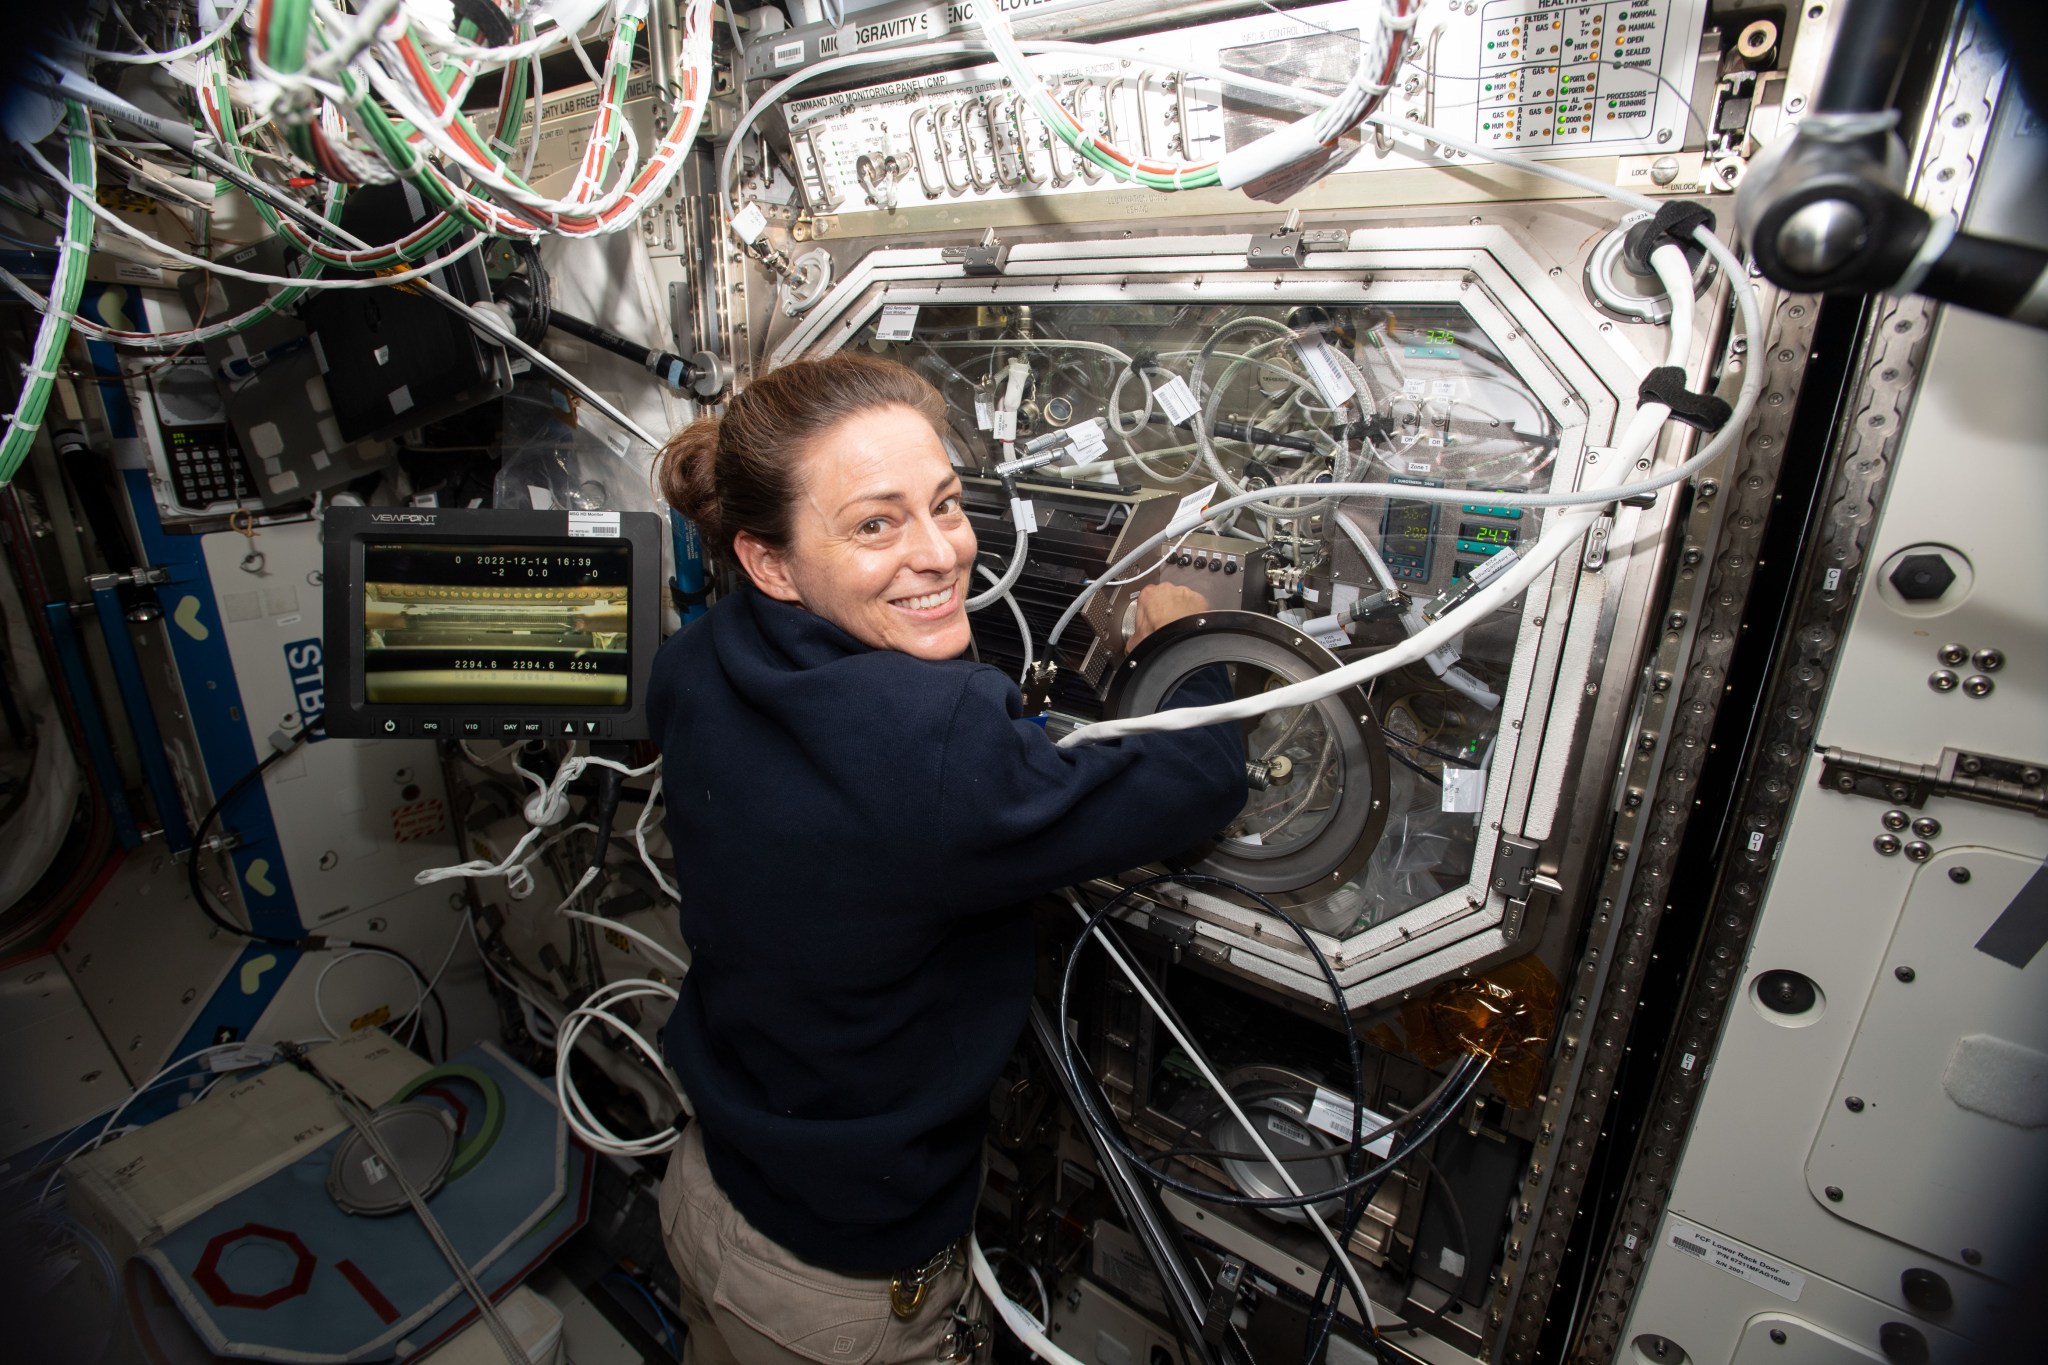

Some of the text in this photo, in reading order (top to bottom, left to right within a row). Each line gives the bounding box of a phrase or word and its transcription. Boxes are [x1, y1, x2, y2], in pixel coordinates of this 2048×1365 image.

[1524, 14, 1549, 23] FILTERS
[1630, 9, 1657, 19] NORMAL
[1535, 24, 1549, 32] GAS
[1628, 22, 1656, 32] MANUAL
[1627, 36, 1645, 44] OPEN
[1574, 43, 1588, 51] HUM
[1625, 47, 1651, 57] SEALED
[1532, 68, 1545, 76] GAS
[790, 74, 949, 113] COMMAND AND MONITORING PANEL (CMP)
[956, 86, 974, 96] POWER
[974, 82, 996, 94] OUTLETS
[1606, 90, 1647, 100] PROCESSORS
[560, 102, 576, 114] LAB
[1618, 99, 1646, 108] RUNNING
[1528, 108, 1542, 116] GAS
[1618, 110, 1646, 119] STOPPED
[1566, 116, 1582, 124] DOOR
[1492, 122, 1504, 130] HUM
[1631, 168, 1649, 176] LOCK
[371, 514, 438, 522] VIEWPOINT
[1476, 527, 1509, 543] 24.7
[477, 556, 548, 566] 2022-12-14
[557, 558, 592, 566] 16:39
[492, 568, 598, 578] -2 0.0 -0
[1828, 570, 1838, 580] C
[454, 660, 598, 670] 2294.6 2294.6 2294
[1752, 834, 1761, 842] D
[1694, 1233, 1711, 1243] FCF
[1712, 1242, 1736, 1255] Lower
[1737, 1252, 1758, 1264] Rack
[1759, 1261, 1780, 1274] Door
[1716, 1250, 1730, 1260] P/N
[1716, 1259, 1744, 1275] S/N 2001
